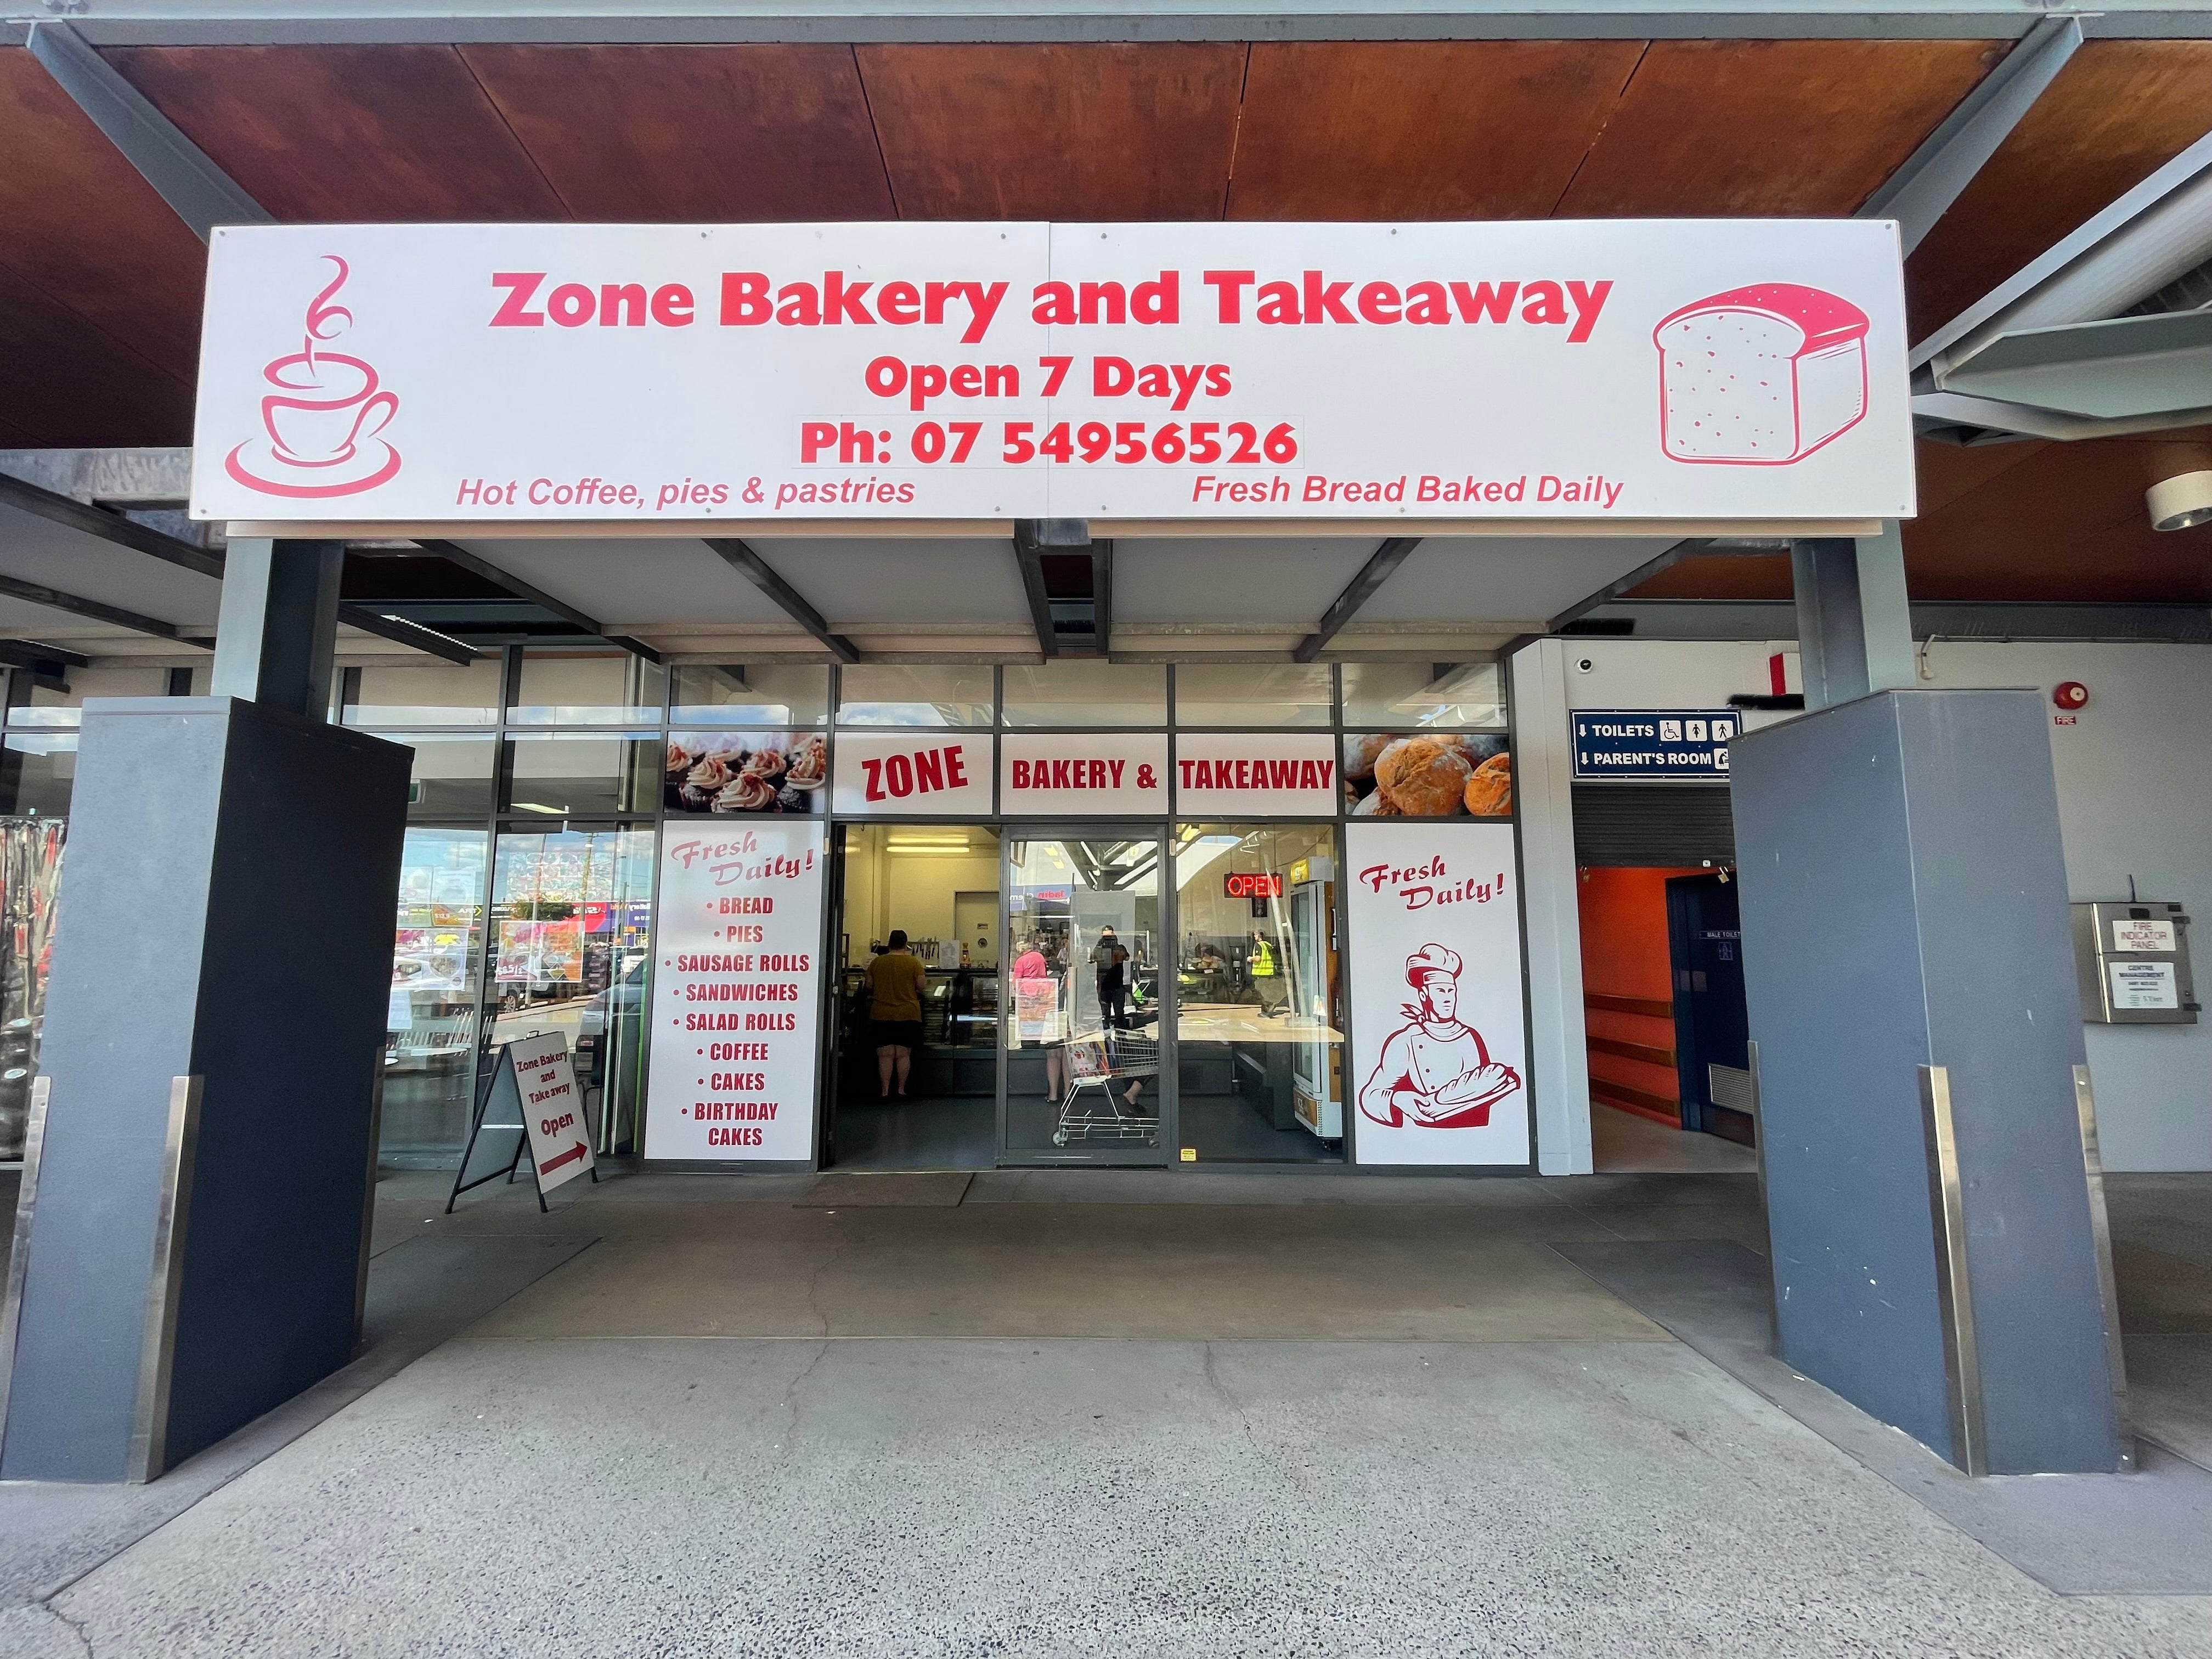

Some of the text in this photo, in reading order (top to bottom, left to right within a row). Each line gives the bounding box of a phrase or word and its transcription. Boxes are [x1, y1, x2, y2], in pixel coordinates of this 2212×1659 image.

[490, 270, 1613, 344] Zone Bakery and Takeaway
[865, 355, 1232, 412] Open 7 Days
[801, 421, 1298, 465] Ph: 07 54956526
[455, 476, 916, 510] Hot Coffee, pies & pastries
[1192, 475, 1623, 509] Fresh Bread Baked Daily
[1592, 724, 1655, 737] TOILETS
[1594, 752, 1712, 765] PARENT'S ROOM
[861, 744, 1334, 802] ZONE BAKERY & TAKEAWAY
[670, 831, 758, 869] Fresh
[709, 848, 814, 886] Daily!
[1359, 855, 1447, 894] Fresh
[1227, 875, 1281, 896] OPEN
[1399, 873, 1505, 911] Daily!
[719, 897, 774, 915] BREAD
[727, 925, 763, 943] PIES
[2132, 922, 2153, 930] FIRE
[2121, 932, 2167, 940] INDICATOR
[2131, 941, 2160, 950] PANEL
[678, 954, 810, 972] SAUSAGE ROLLS
[686, 983, 798, 1002] SANDWICHES
[686, 1013, 795, 1031] SALAD ROLLS
[709, 1042, 769, 1061] COFFEE
[516, 1051, 568, 1073] Zone Bakery
[540, 1069, 556, 1083] and
[710, 1073, 765, 1091] CAKES
[694, 1102, 778, 1121] BIRTHDAY
[540, 1112, 574, 1138] Open
[708, 1127, 763, 1146] CAKES
